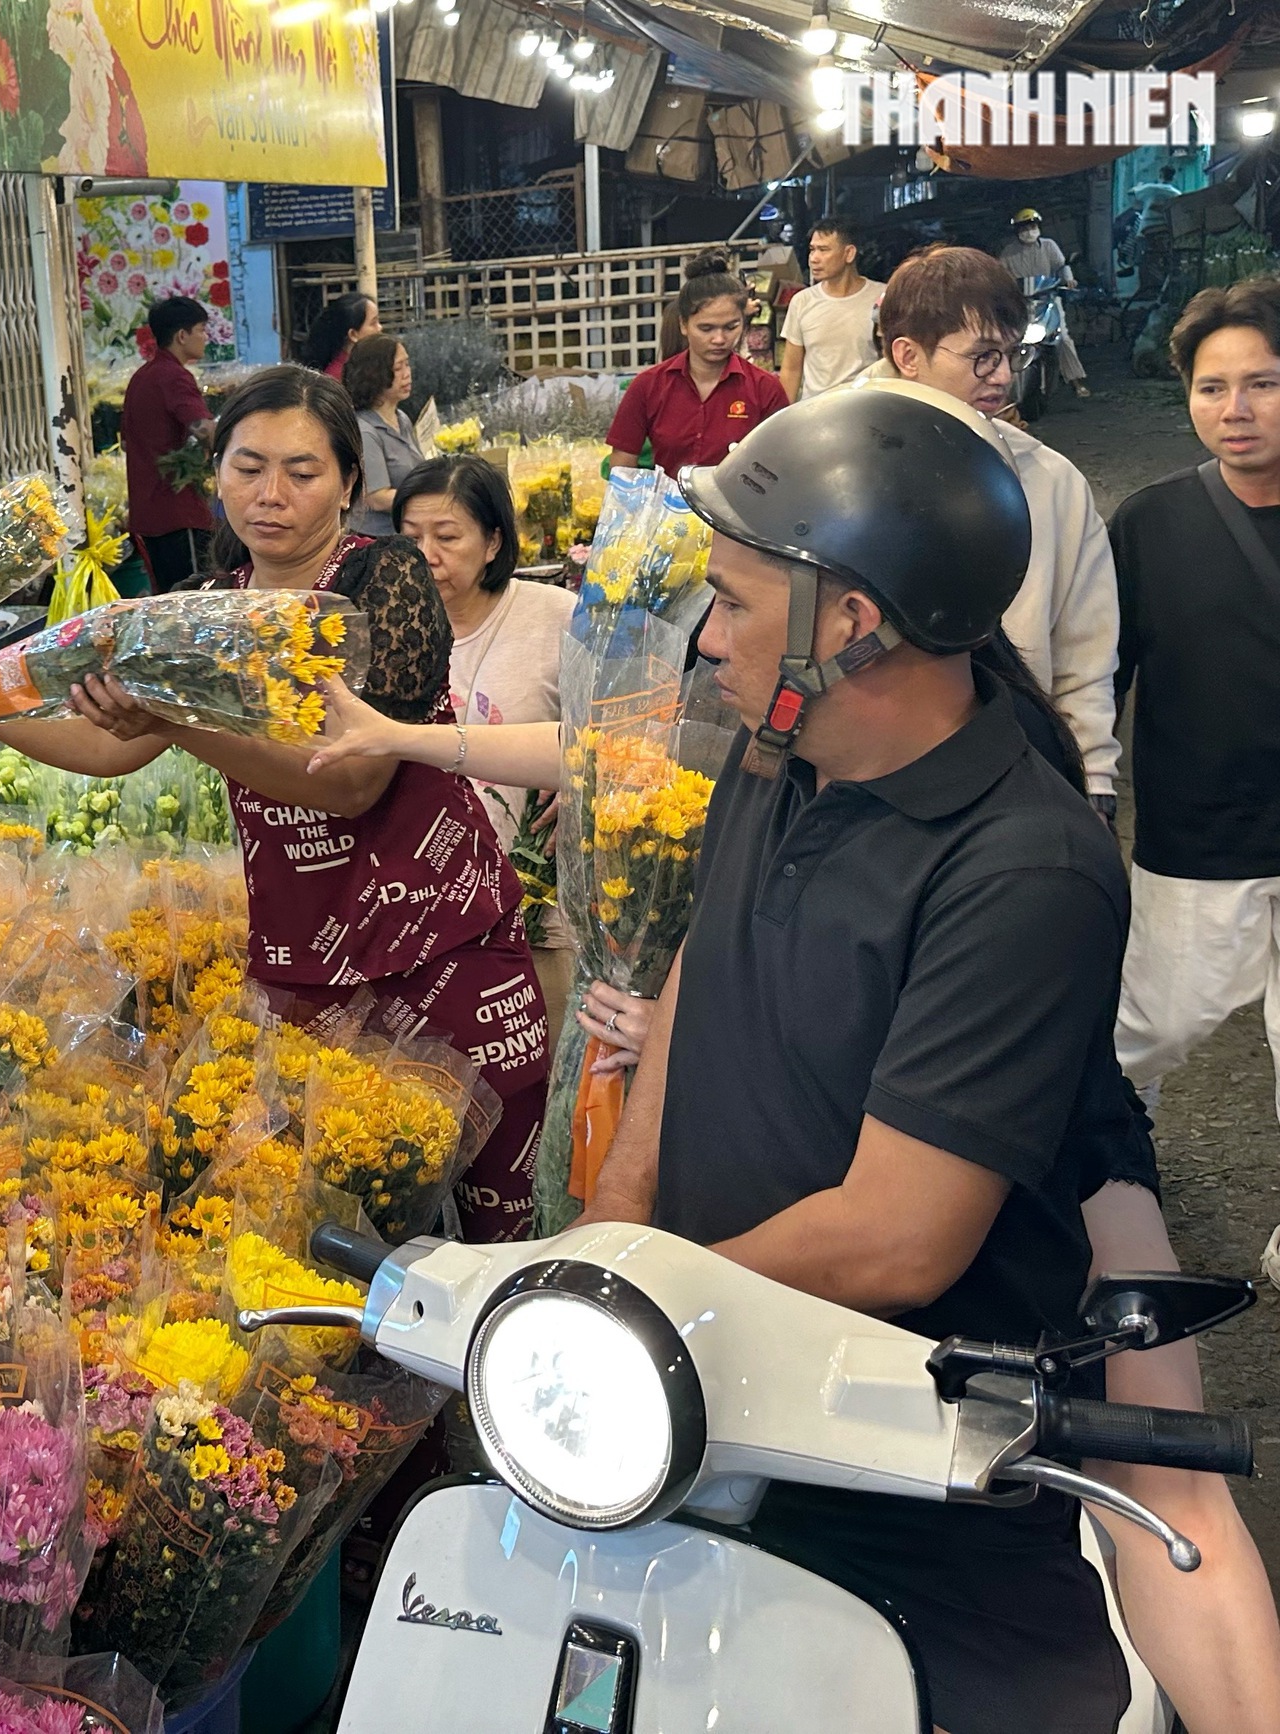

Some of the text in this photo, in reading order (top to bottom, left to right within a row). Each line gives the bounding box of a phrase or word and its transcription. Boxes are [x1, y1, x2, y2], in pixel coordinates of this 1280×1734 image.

[240, 801, 262, 813] THE
[297, 824, 329, 840] THE
[283, 834, 355, 860] WORLD
[434, 845, 455, 875] MOST
[408, 884, 438, 904] THE
[418, 961, 458, 1011] TRUE LOVE
[475, 984, 536, 1023] WORLD
[503, 1011, 531, 1033] THE
[501, 1056, 527, 1072] CAN
[502, 1196, 535, 1214] THE
[397, 1572, 503, 1636] Vespa
